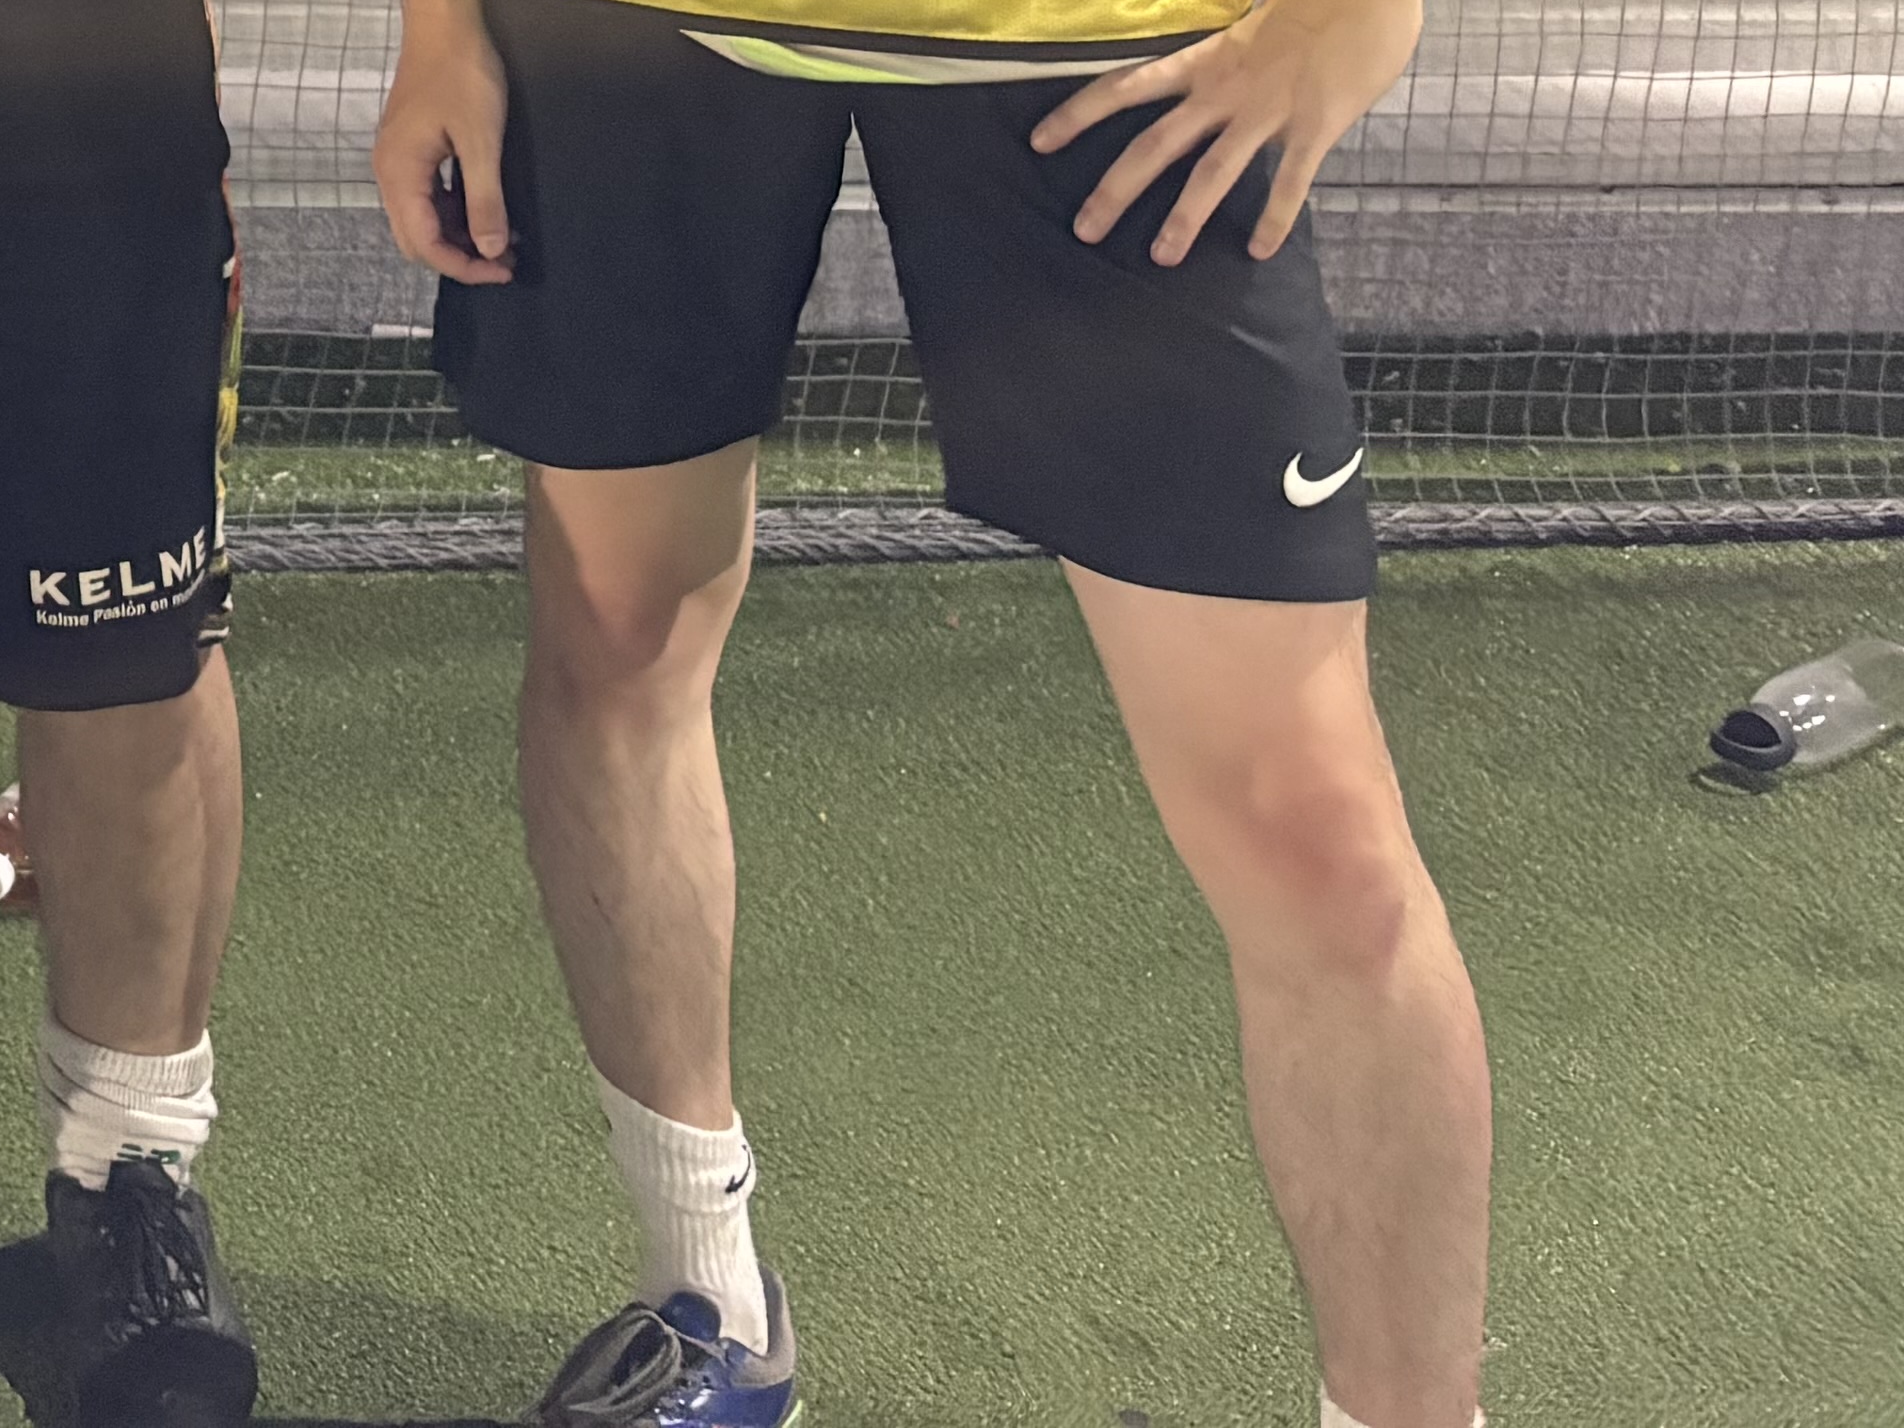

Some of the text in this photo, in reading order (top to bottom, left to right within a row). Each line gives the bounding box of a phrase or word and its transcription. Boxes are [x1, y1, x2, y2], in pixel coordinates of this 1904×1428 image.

[29, 526, 207, 607] KELME
[36, 610, 90, 627] Kelme
[150, 596, 169, 613] en
